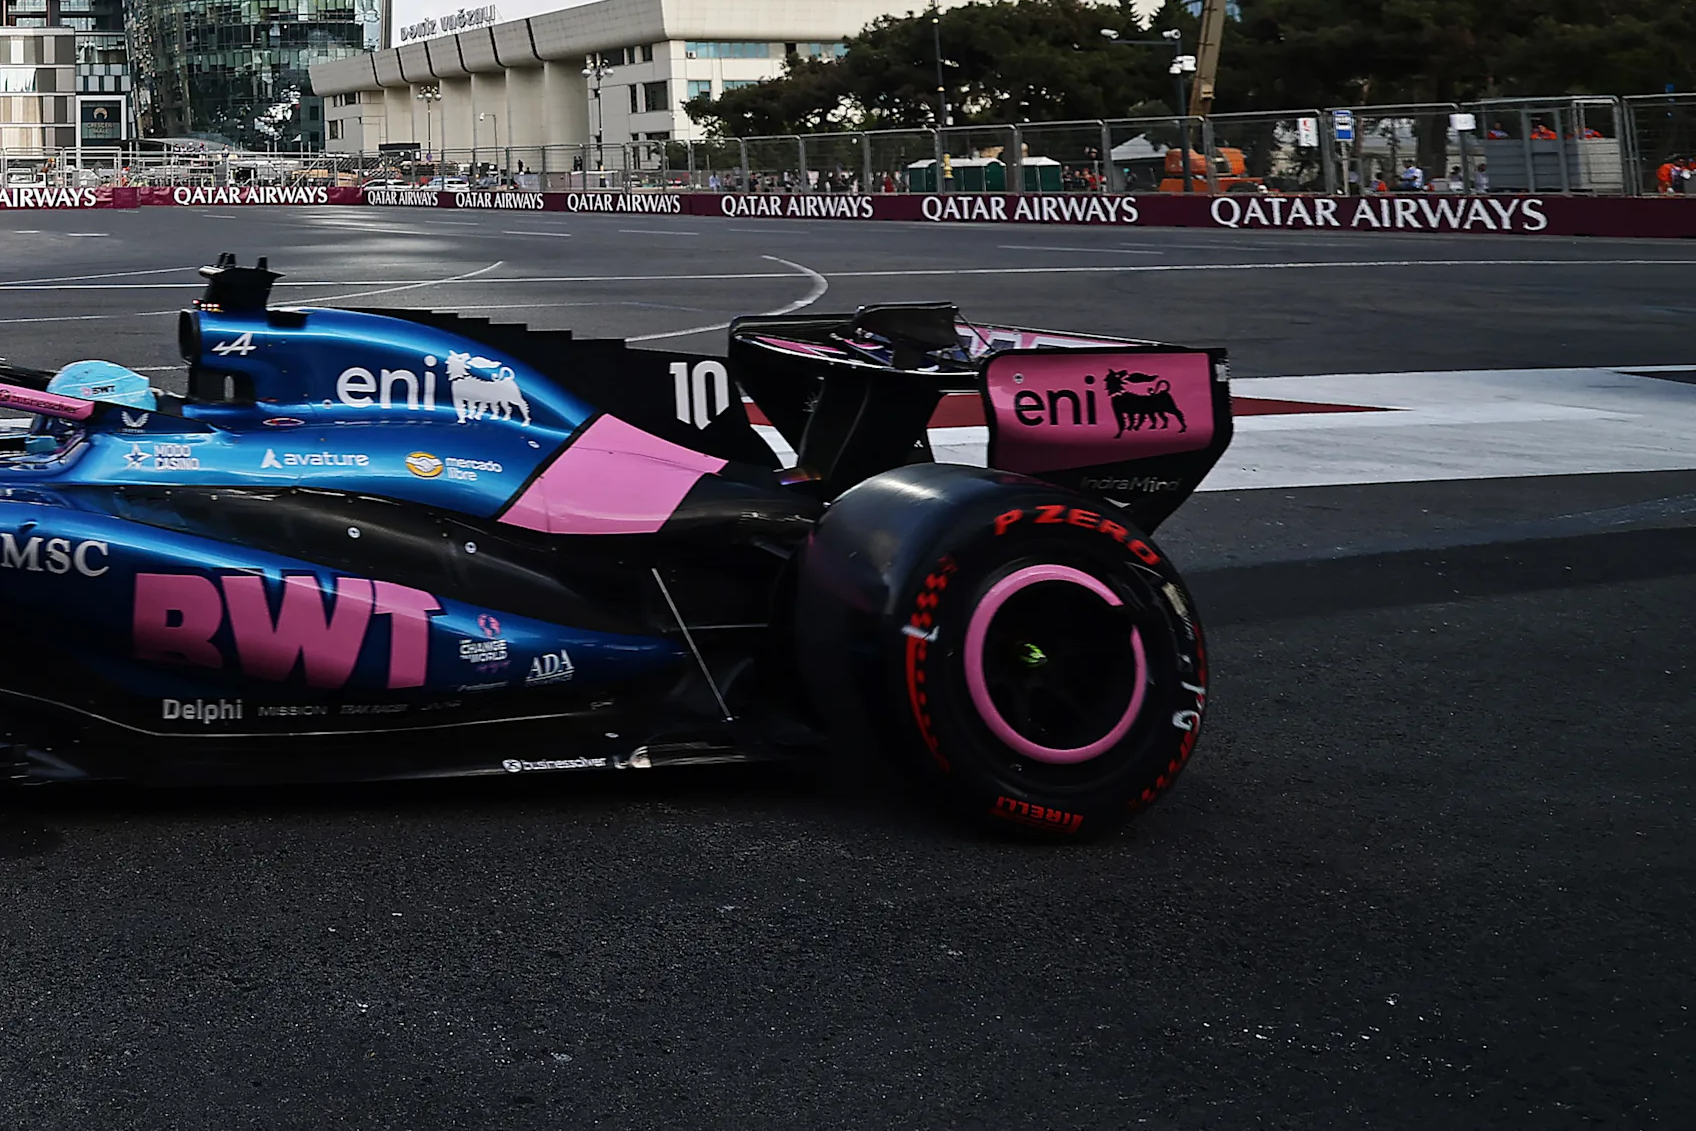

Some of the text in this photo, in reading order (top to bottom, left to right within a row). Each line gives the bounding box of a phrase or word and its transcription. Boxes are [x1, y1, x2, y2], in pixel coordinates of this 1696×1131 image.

[173, 186, 328, 205] QATAR AIRWAYS
[367, 190, 438, 207] QATAR AIRWAYS
[455, 192, 544, 210] QATAR AIRWAYS
[567, 193, 681, 213] QATAR AIRWAYS
[720, 194, 874, 219] QATAR AIRWAYS
[921, 196, 1139, 223] QATAR AIRWAYS
[1210, 197, 1548, 231] QATAR AIRWAYS
[336, 354, 437, 411] eni
[669, 360, 730, 430] 10
[1014, 374, 1097, 427] eni
[154, 444, 191, 457] MODO
[283, 451, 369, 467] avature
[154, 457, 200, 470] CASINO
[444, 457, 503, 474] mercado
[447, 468, 478, 481] libre
[993, 504, 1161, 566] P ZERO
[0, 533, 109, 577] MSC
[133, 572, 442, 689] BWT
[525, 649, 575, 678] ADA
[162, 699, 243, 724] Delphi
[258, 706, 328, 717] MISSION
[991, 796, 1084, 833] PIRELLI
